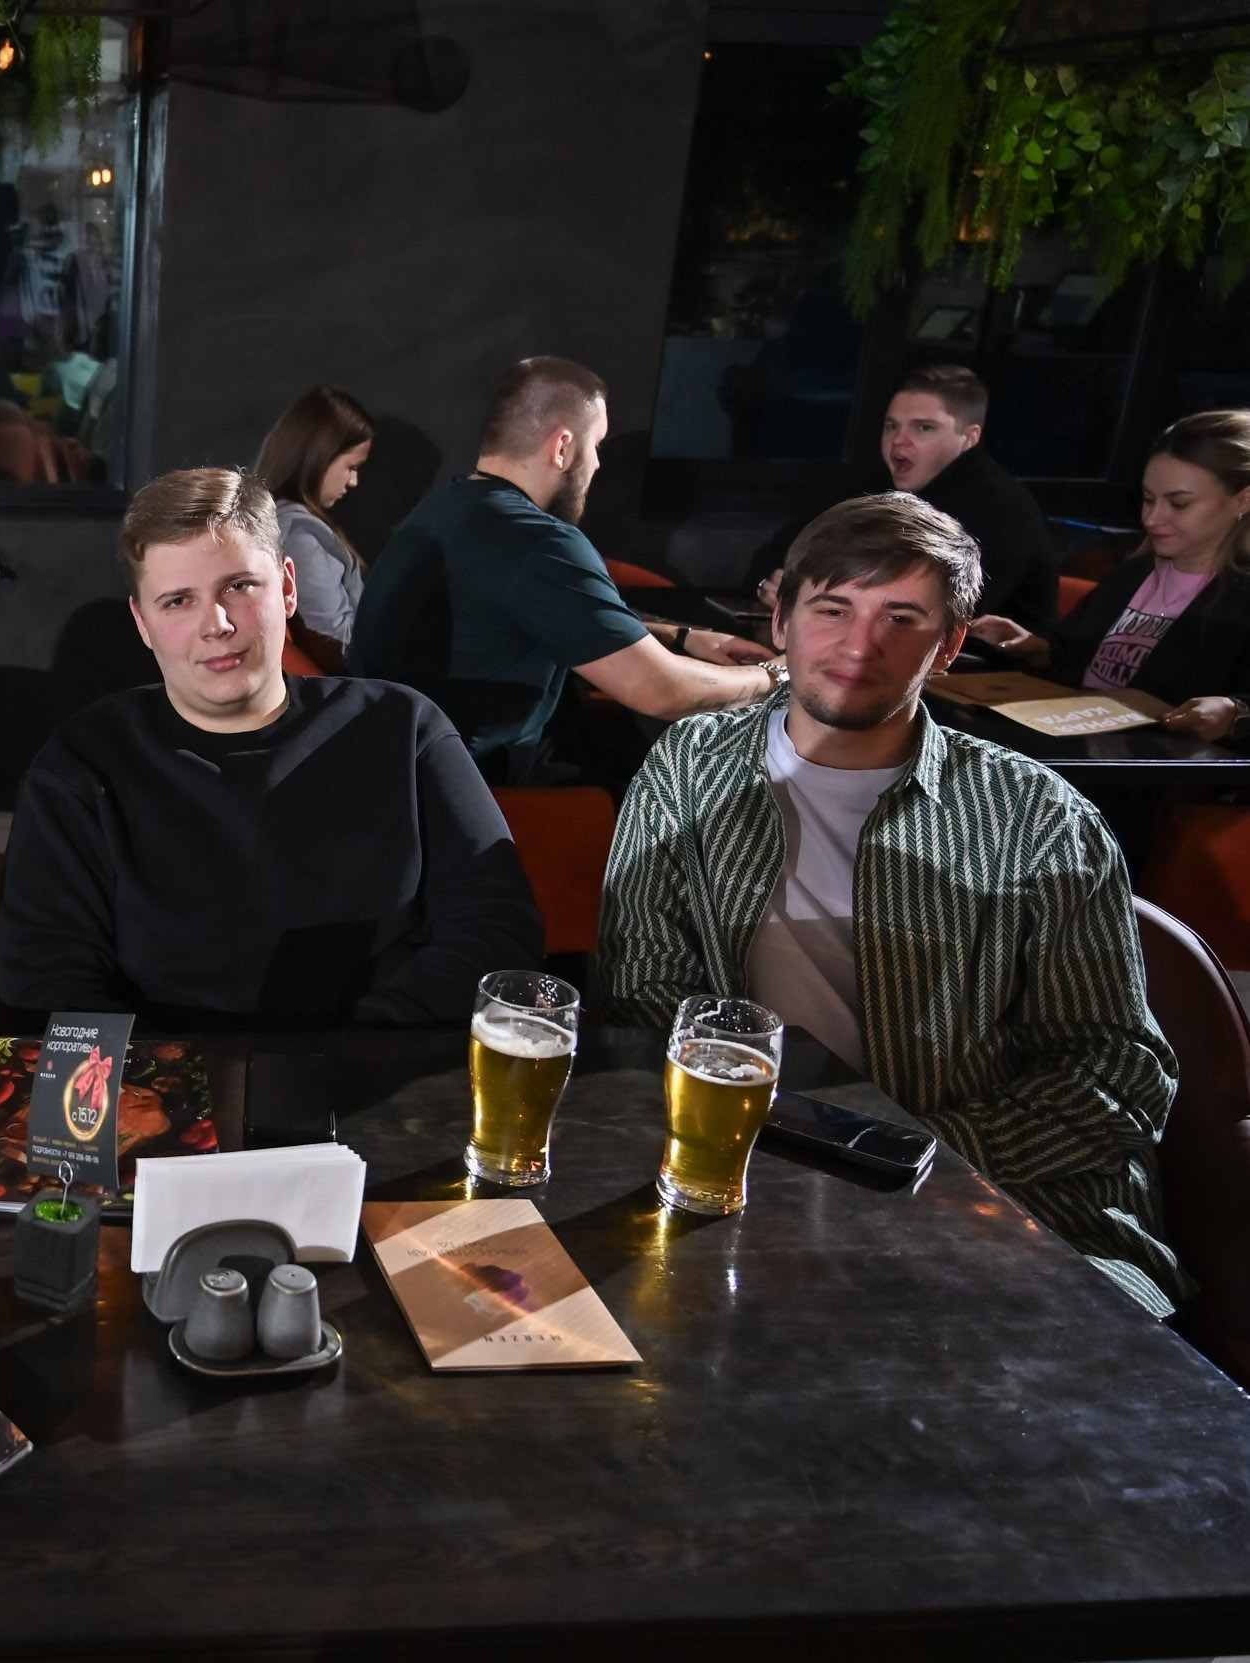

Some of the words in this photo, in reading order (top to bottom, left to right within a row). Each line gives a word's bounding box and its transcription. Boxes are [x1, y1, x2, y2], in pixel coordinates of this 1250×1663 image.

[1035, 706, 1110, 724] КАРТА
[1054, 713, 1145, 732] БАРНАЯ
[50, 1024, 99, 1040] Новогодние
[46, 1041, 94, 1054] корпоративы
[78, 1106, 97, 1124] 15.12
[483, 1334, 562, 1342] MERZEN
